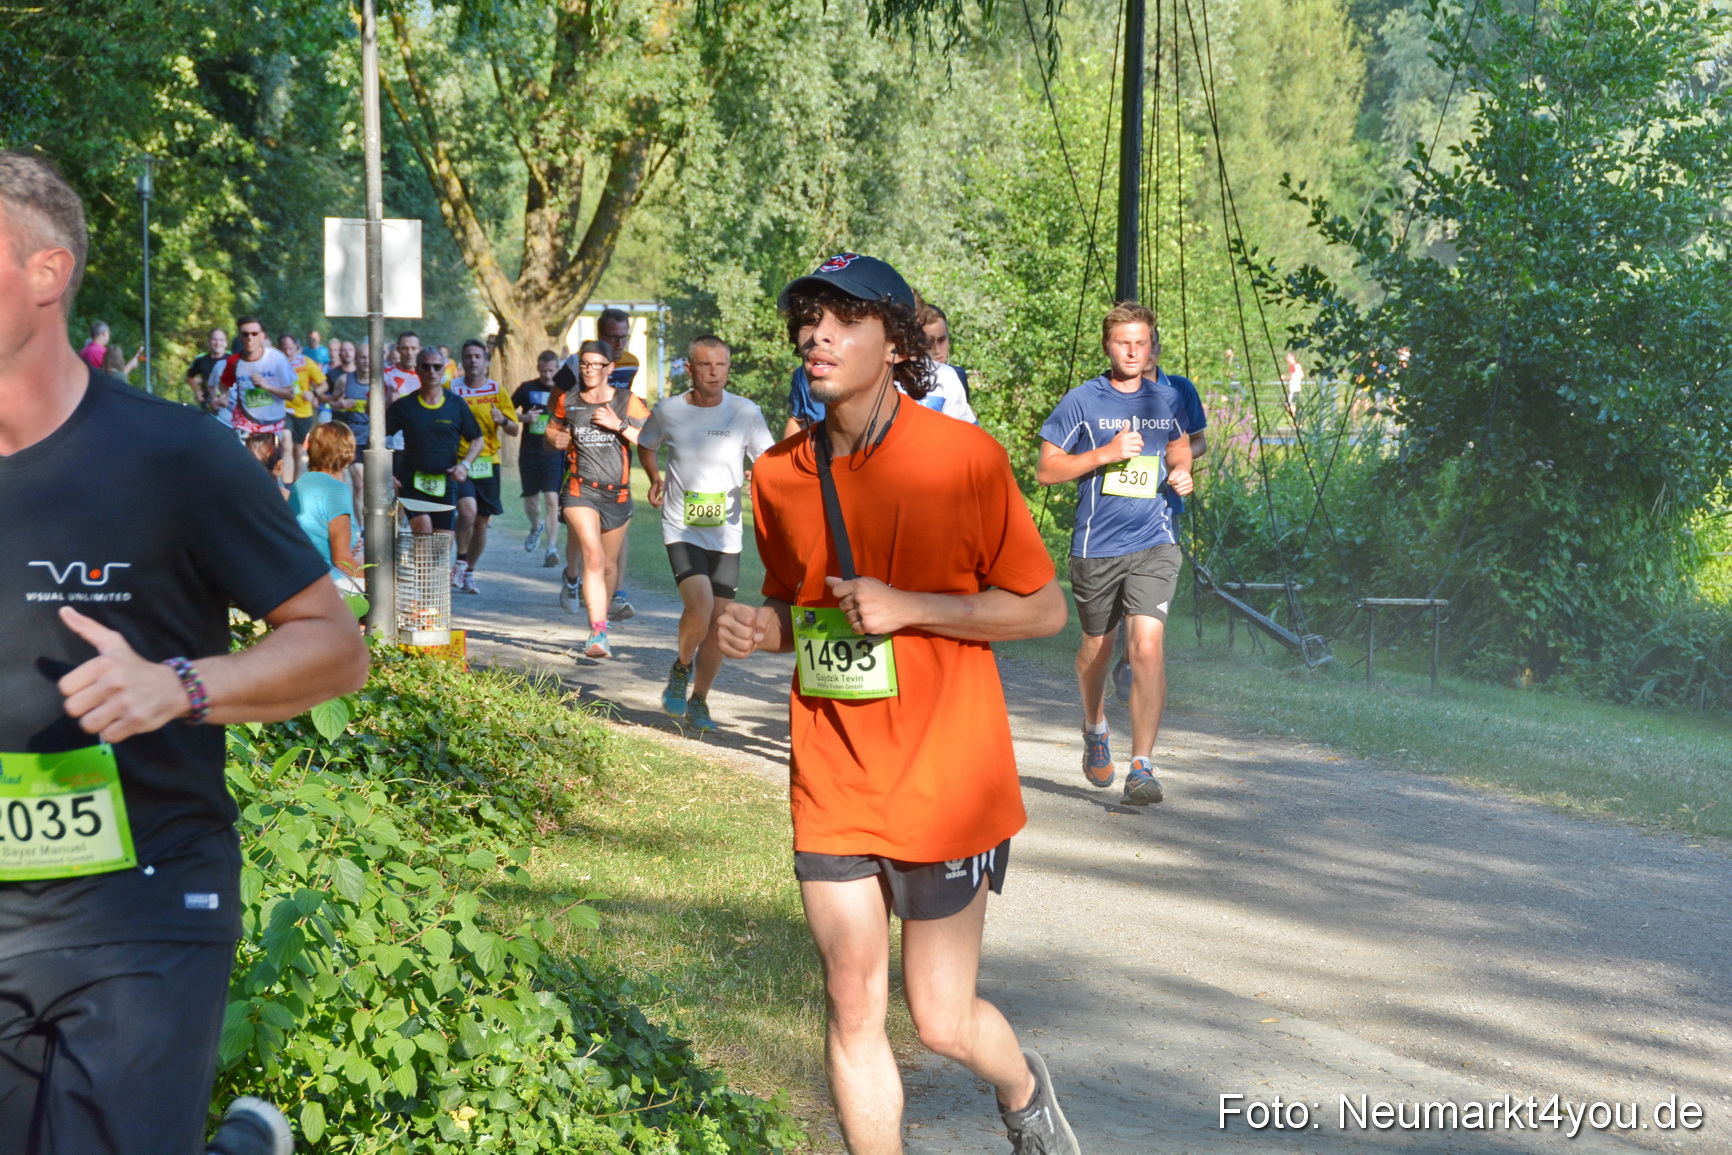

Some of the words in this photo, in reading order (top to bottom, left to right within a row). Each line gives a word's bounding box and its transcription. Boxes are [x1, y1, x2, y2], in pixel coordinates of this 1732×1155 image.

[1099, 418, 1131, 430] EURO
[1141, 418, 1170, 430] POLES
[578, 434, 615, 443] DESIGN
[1118, 469, 1148, 486] 530
[420, 478, 438, 489] 283
[688, 503, 721, 518] 2088
[26, 591, 65, 602] VISUAL
[68, 592, 132, 602] UNLIMITED
[804, 639, 877, 673] 1493
[815, 673, 840, 683] Gajdzik
[841, 673, 864, 682] Tevin
[845, 682, 863, 690] GmbH
[40, 842, 87, 856] Manuel
[945, 869, 968, 880] adidas
